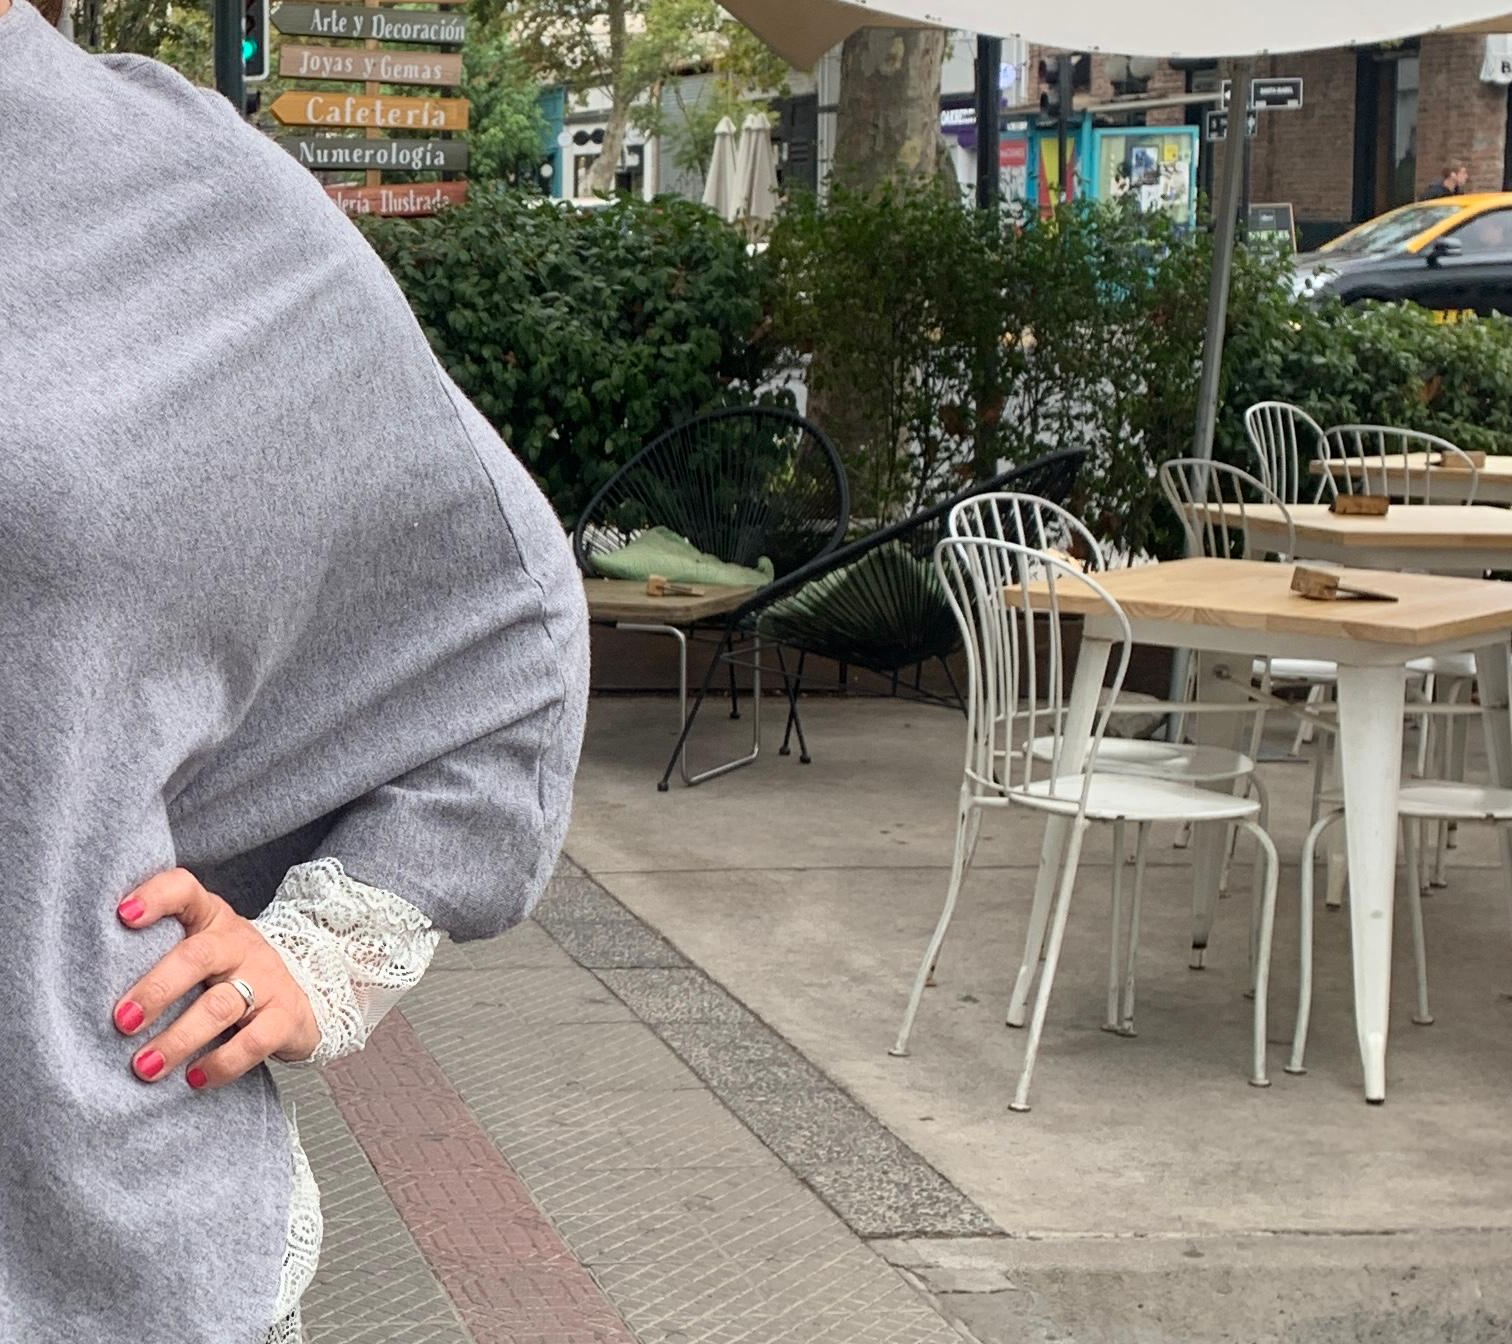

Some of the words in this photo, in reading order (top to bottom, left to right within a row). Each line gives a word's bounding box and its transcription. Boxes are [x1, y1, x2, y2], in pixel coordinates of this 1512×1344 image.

[310, 8, 348, 34] Arte
[352, 15, 364, 37] y
[371, 13, 466, 41] Decoración
[299, 50, 354, 78] Joyas
[363, 57, 376, 79] y
[380, 54, 443, 80] Gemas
[306, 96, 446, 127] Cafetería
[299, 142, 445, 170] Numerología
